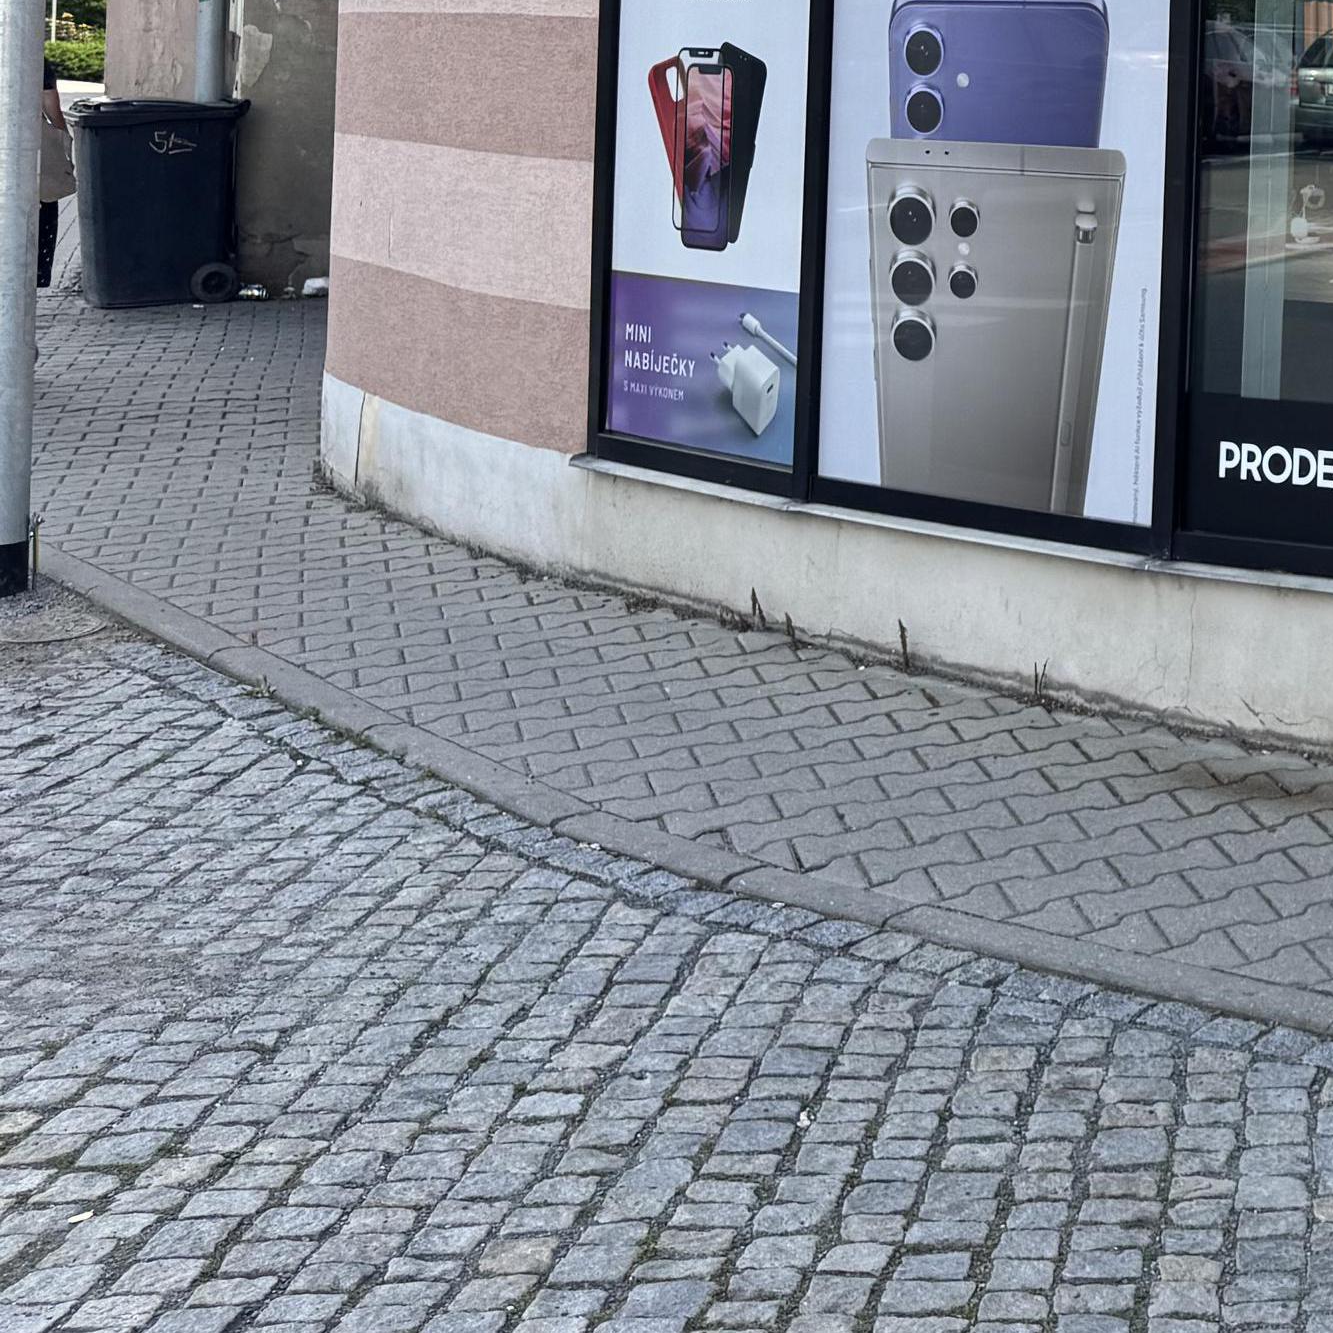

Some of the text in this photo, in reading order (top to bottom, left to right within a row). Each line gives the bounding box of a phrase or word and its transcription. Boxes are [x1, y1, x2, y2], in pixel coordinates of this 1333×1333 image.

[625, 322, 652, 344] MINI
[624, 347, 696, 378] NABÍJEČKY
[623, 380, 684, 401] S MAXI VÝKONEM
